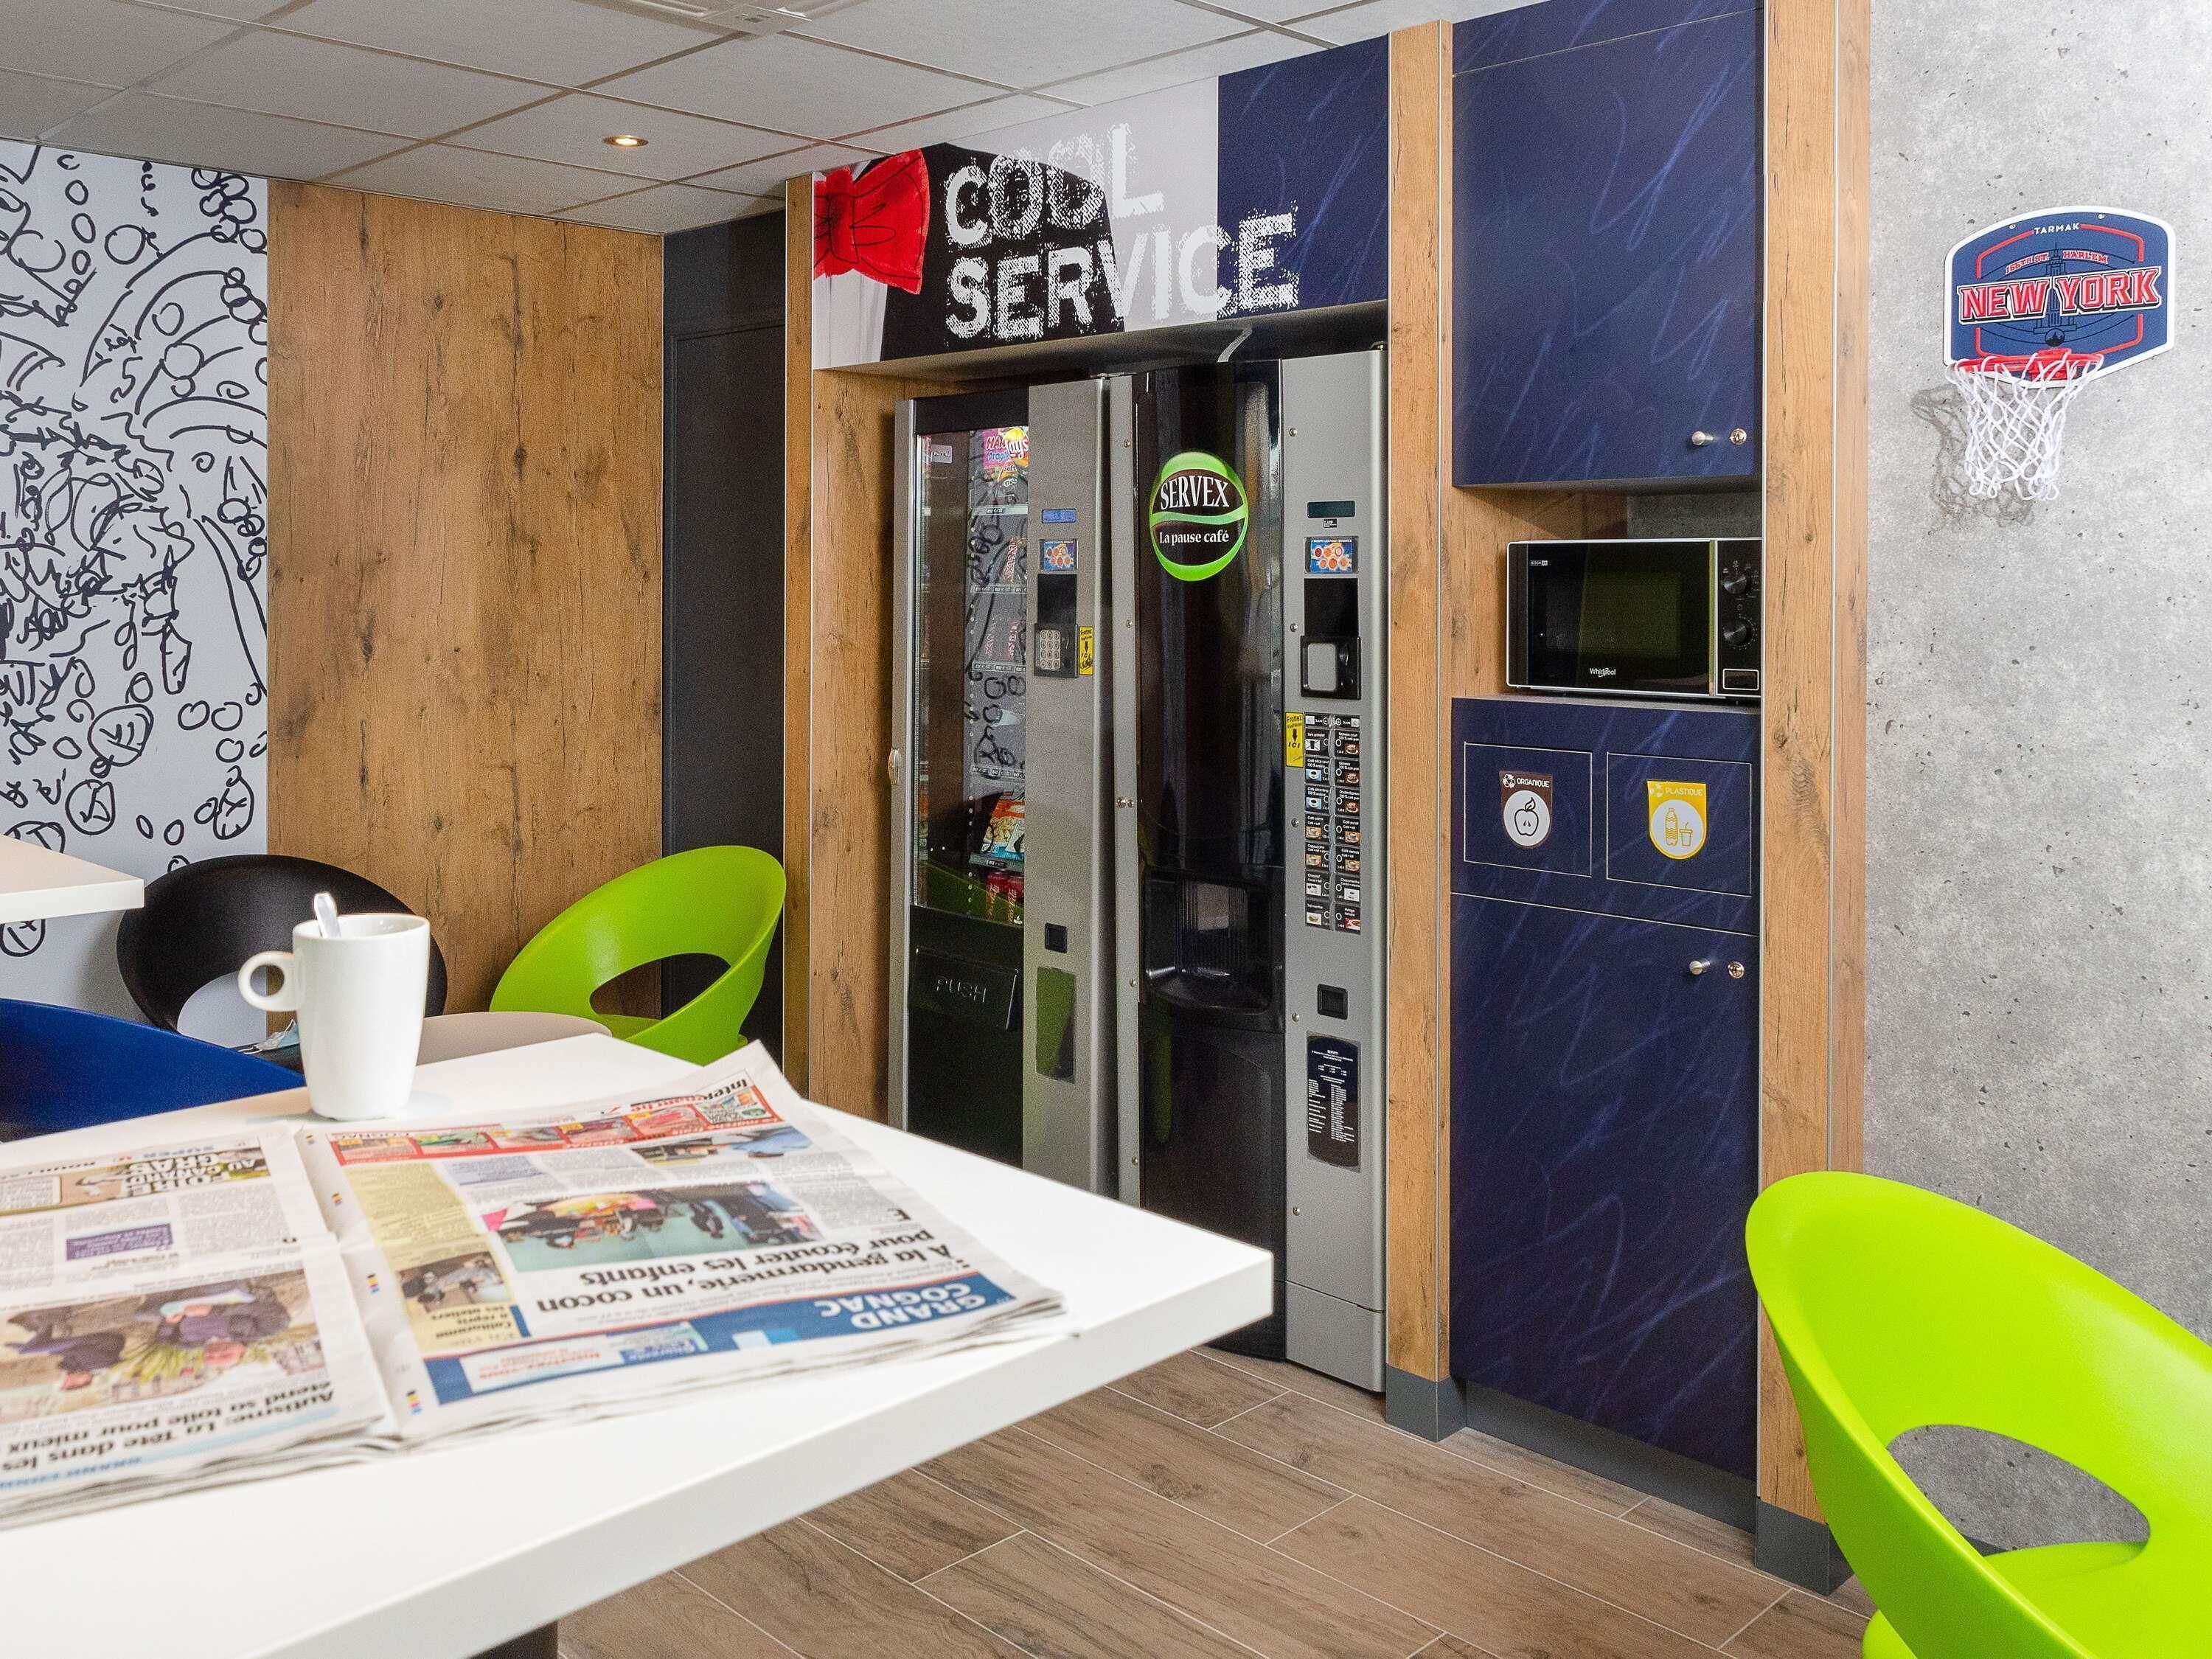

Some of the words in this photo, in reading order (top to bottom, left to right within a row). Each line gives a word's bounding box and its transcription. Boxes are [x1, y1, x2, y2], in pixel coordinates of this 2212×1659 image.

[943, 123, 1164, 248] COOL
[2034, 223, 2081, 235] TARMAK
[2062, 250, 2109, 264] HARLEM
[944, 209, 1300, 341] SERVICE
[1958, 279, 2051, 324] NEW
[2056, 267, 2162, 316] YORK
[1160, 475, 1230, 510] SERVEX
[1159, 532, 1170, 543] La
[1171, 532, 1201, 546] pause
[1203, 529, 1229, 543] café
[1589, 667, 1616, 678] Whirlpool
[1516, 777, 1550, 788] ORGANIQUE
[1665, 786, 1703, 797] PLASTIQUE
[936, 978, 987, 1003] PUSH
[124, 1152, 221, 1176] GRAS
[227, 1158, 256, 1172] AU
[125, 1165, 221, 1186] CANARD
[868, 1228, 934, 1250] pour
[703, 1256, 747, 1271] les
[754, 1242, 860, 1267] écouter
[894, 1248, 927, 1263] la
[578, 1262, 695, 1287] enfants
[687, 1252, 888, 1291] gendarmerie,
[536, 1290, 633, 1313] cocon
[641, 1284, 684, 1301] un
[814, 1282, 972, 1318] COGNAC
[849, 1294, 987, 1330] GRAND
[167, 1407, 222, 1426] toile
[231, 1401, 256, 1412] sa
[101, 1416, 159, 1437] pour
[186, 1422, 215, 1435] La
[8, 1430, 89, 1454] mieux
[123, 1430, 173, 1449] Tête
[48, 1441, 114, 1463] dans
[2, 1456, 38, 1472] les
